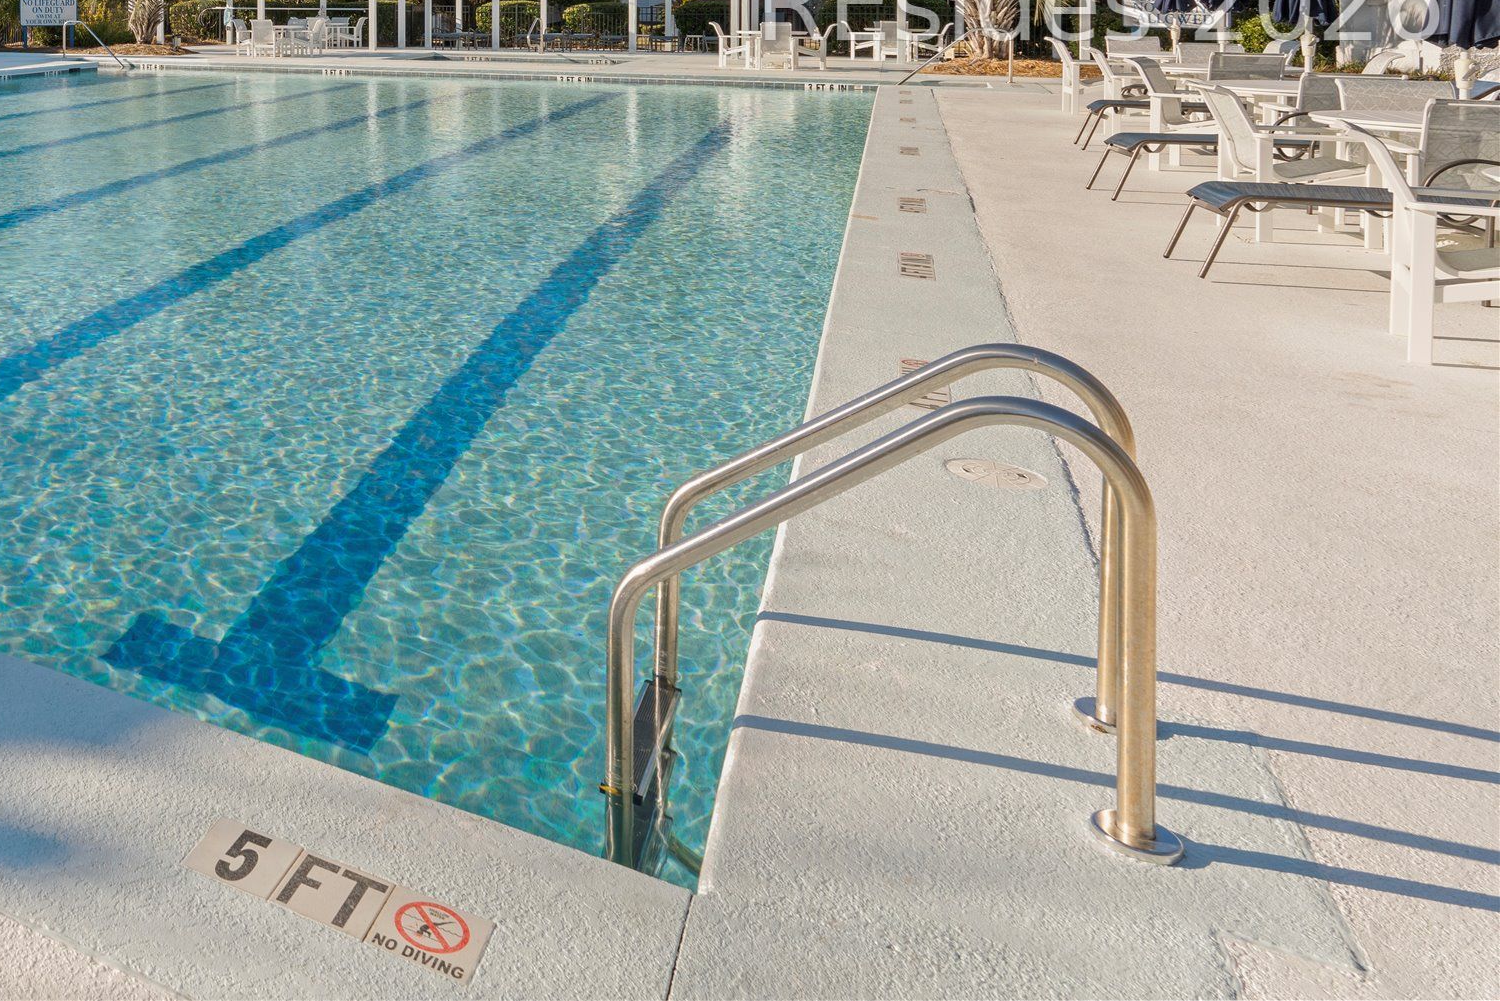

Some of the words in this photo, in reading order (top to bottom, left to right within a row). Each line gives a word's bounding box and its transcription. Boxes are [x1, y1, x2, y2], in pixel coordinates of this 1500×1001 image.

[1132, 2, 1154, 13] NO
[816, 83, 825, 91] FT
[214, 829, 273, 882] 5
[275, 853, 390, 929] FT
[371, 932, 398, 952] NO
[401, 946, 465, 980] DIVING
